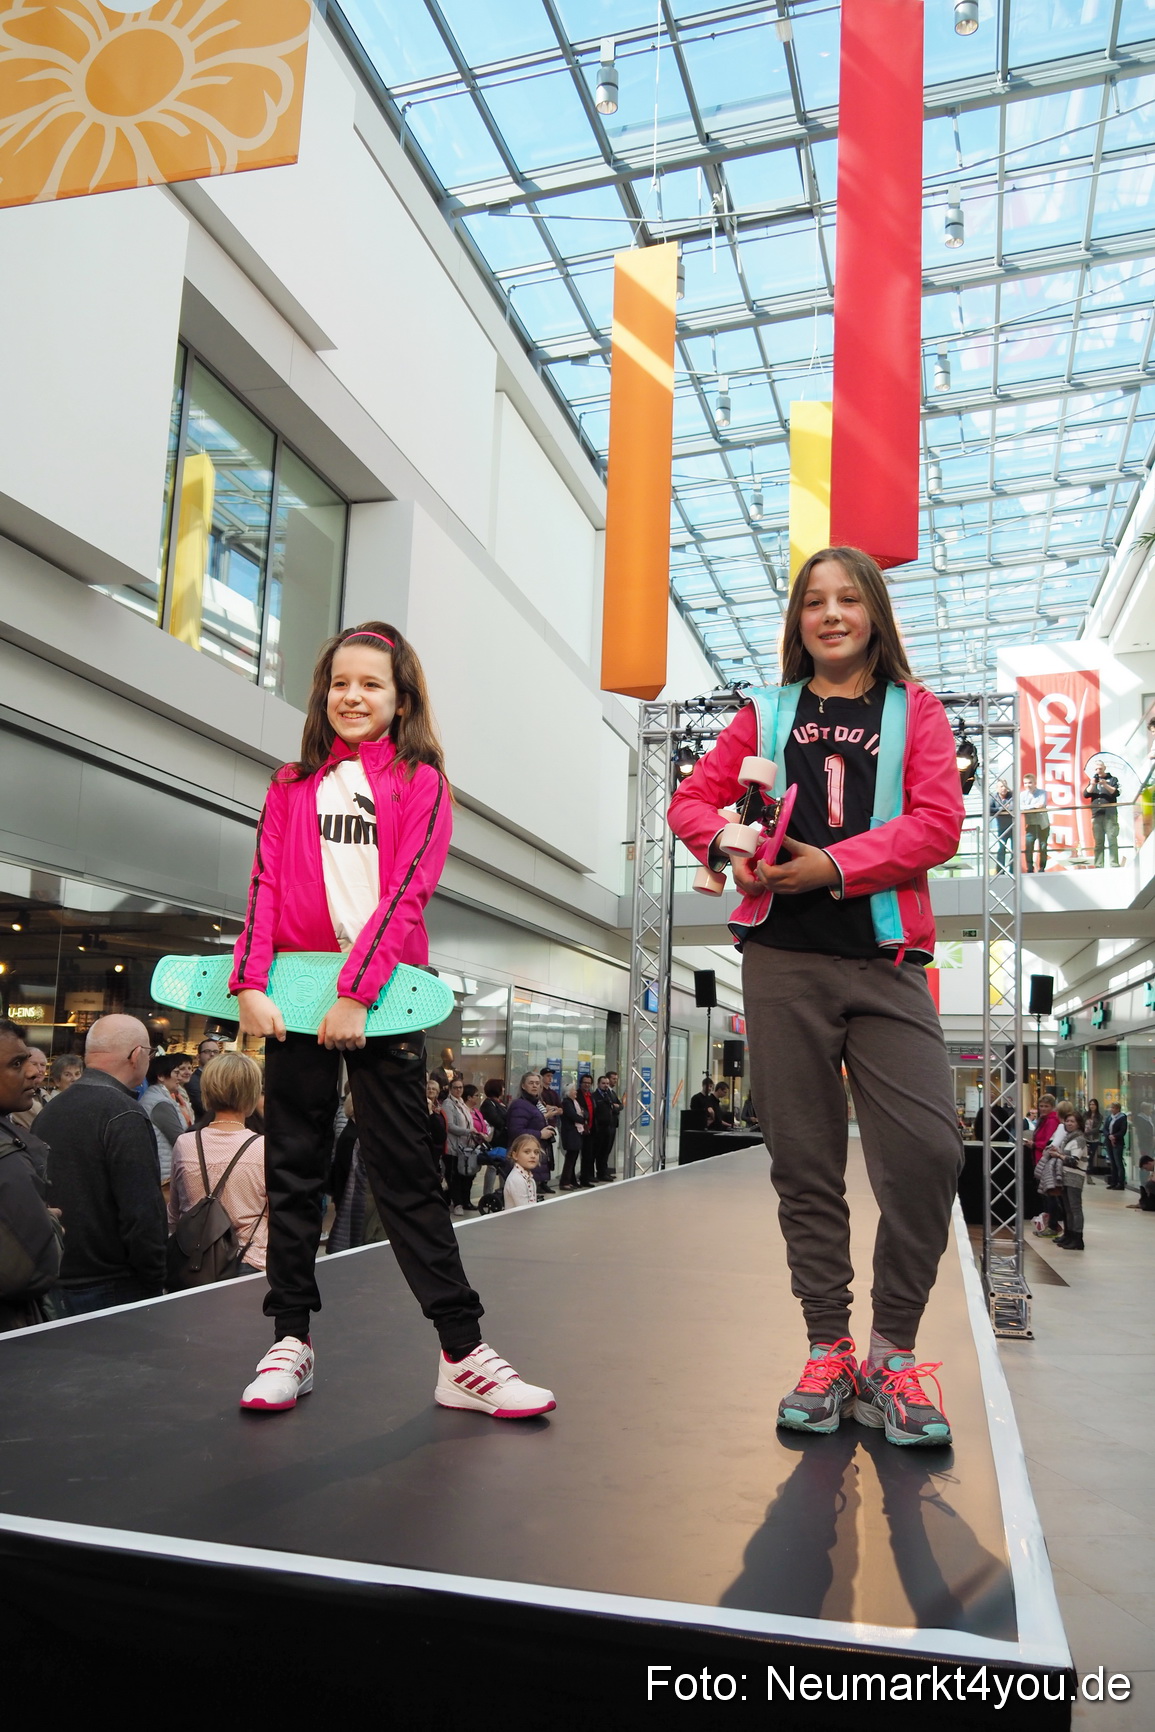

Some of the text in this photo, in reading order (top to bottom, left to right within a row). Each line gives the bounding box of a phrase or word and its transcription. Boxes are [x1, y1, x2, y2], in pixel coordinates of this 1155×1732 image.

[792, 722, 831, 744] UST
[834, 725, 865, 743] DO
[824, 753, 845, 828] 1
[1038, 693, 1077, 872] CINEPLEX
[317, 813, 378, 846] UMA
